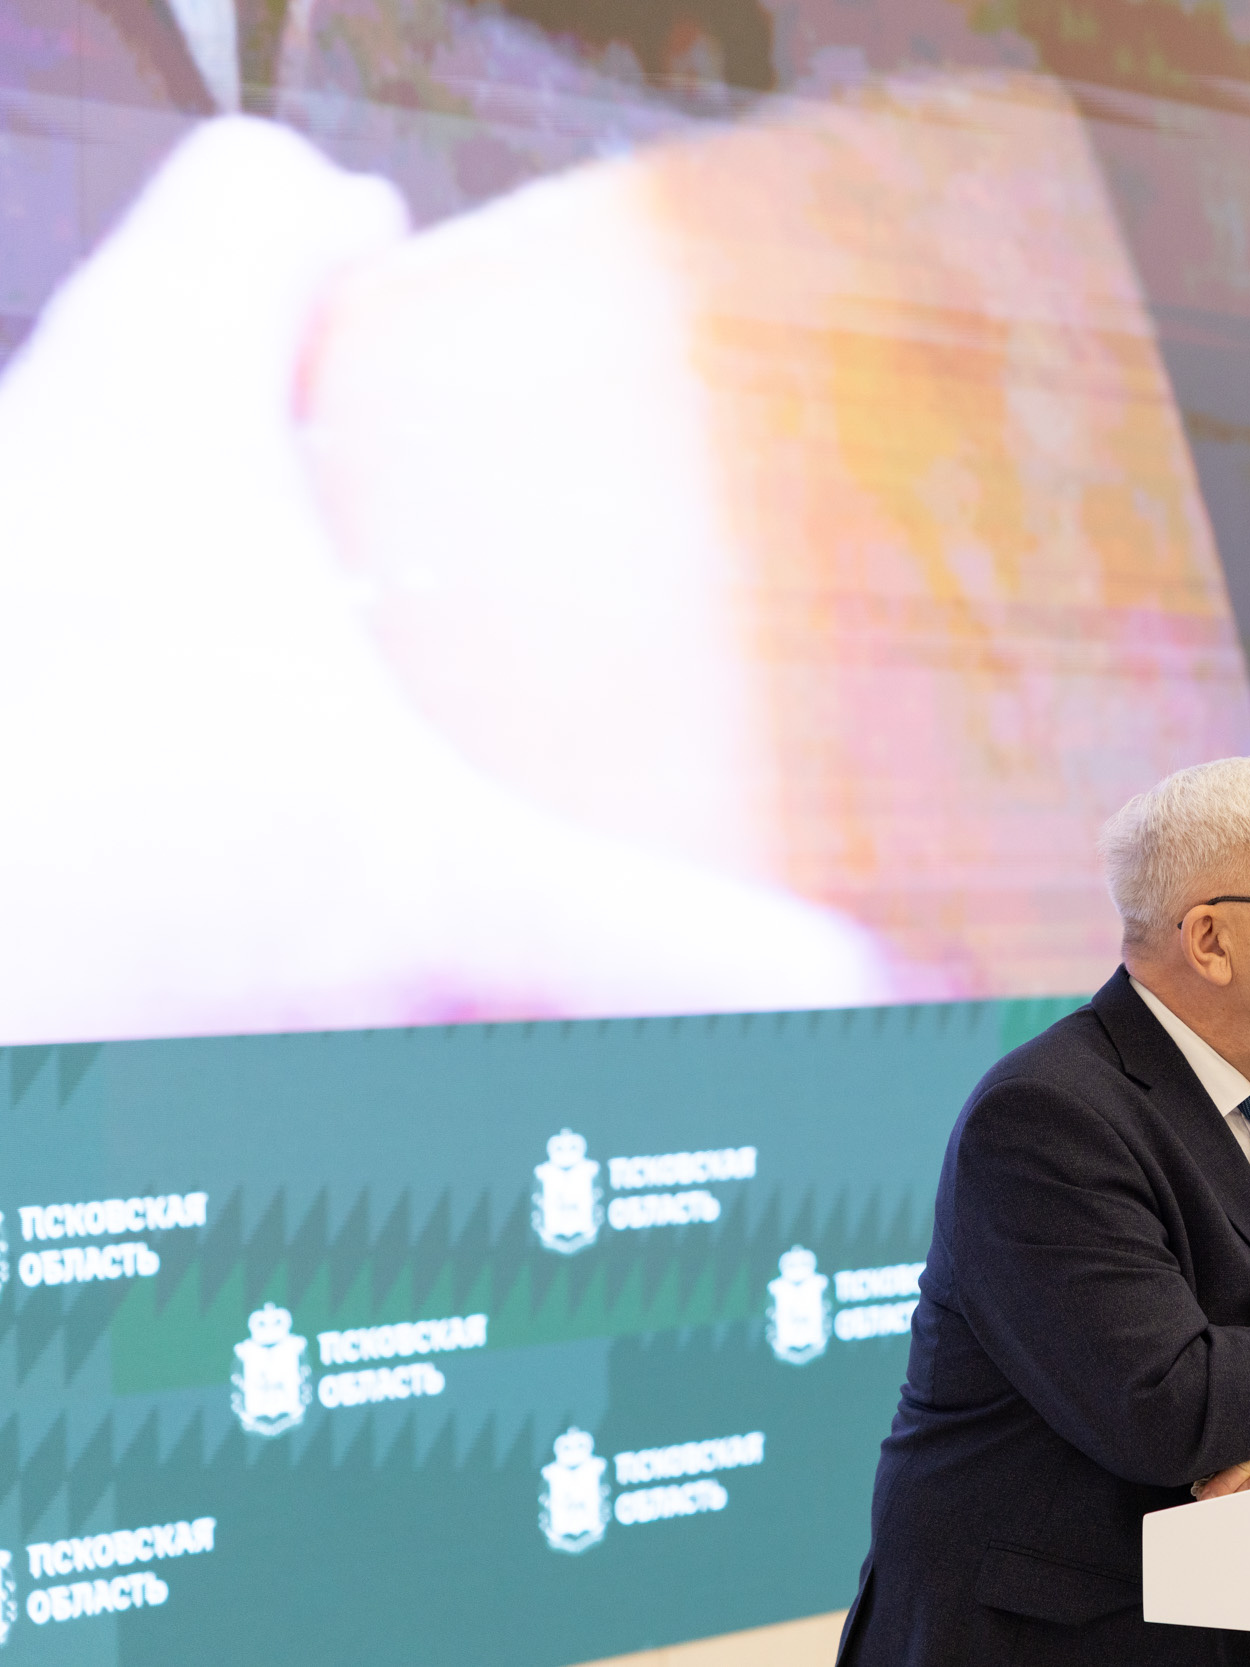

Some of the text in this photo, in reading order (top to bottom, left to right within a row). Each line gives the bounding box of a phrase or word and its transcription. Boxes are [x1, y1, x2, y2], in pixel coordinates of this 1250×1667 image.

[18, 1192, 208, 1241] ПСКОВСКАЯ
[18, 1242, 160, 1287] ОБЛАСТЬ
[317, 1314, 487, 1366] ПСКОВСКАЯ
[318, 1363, 445, 1408] ОБЛАСТЬ
[26, 1517, 216, 1578] ПСКОВСКАЯ
[26, 1572, 169, 1624] ОБЛАСТЬ
